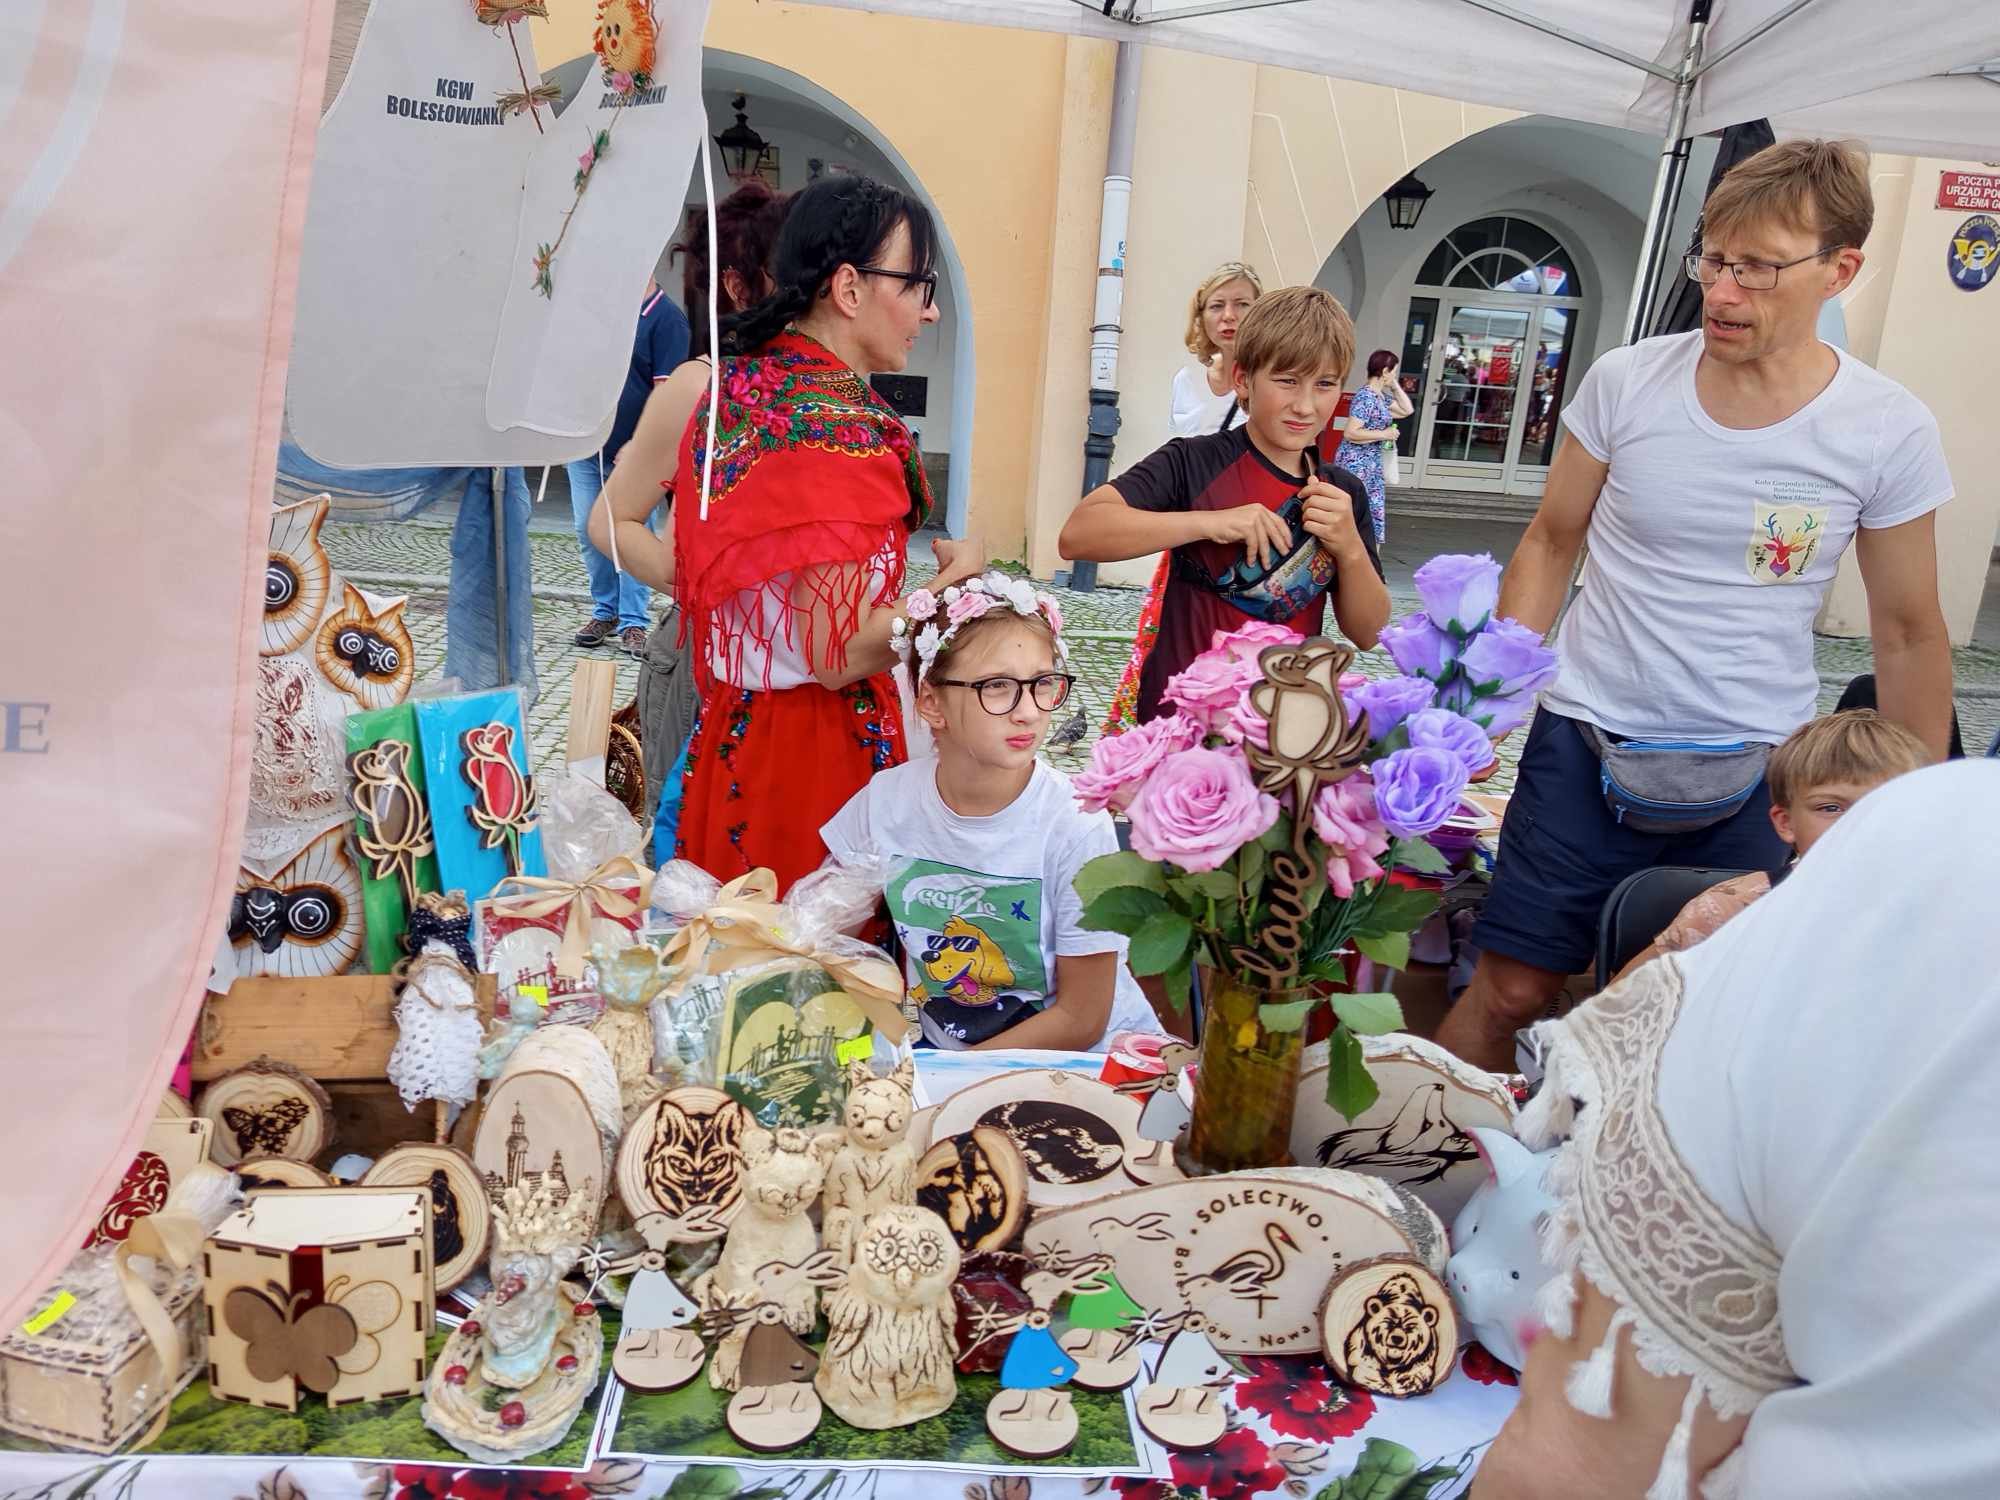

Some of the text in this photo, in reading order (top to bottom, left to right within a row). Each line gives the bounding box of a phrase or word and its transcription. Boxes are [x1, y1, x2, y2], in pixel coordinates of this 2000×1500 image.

[436, 78, 474, 101] KGW
[1957, 175, 1992, 187] POCZTA
[1954, 197, 1989, 209] JELENIA
[1230, 855, 1317, 985] love
[1260, 1325, 1311, 1348] Nowa
